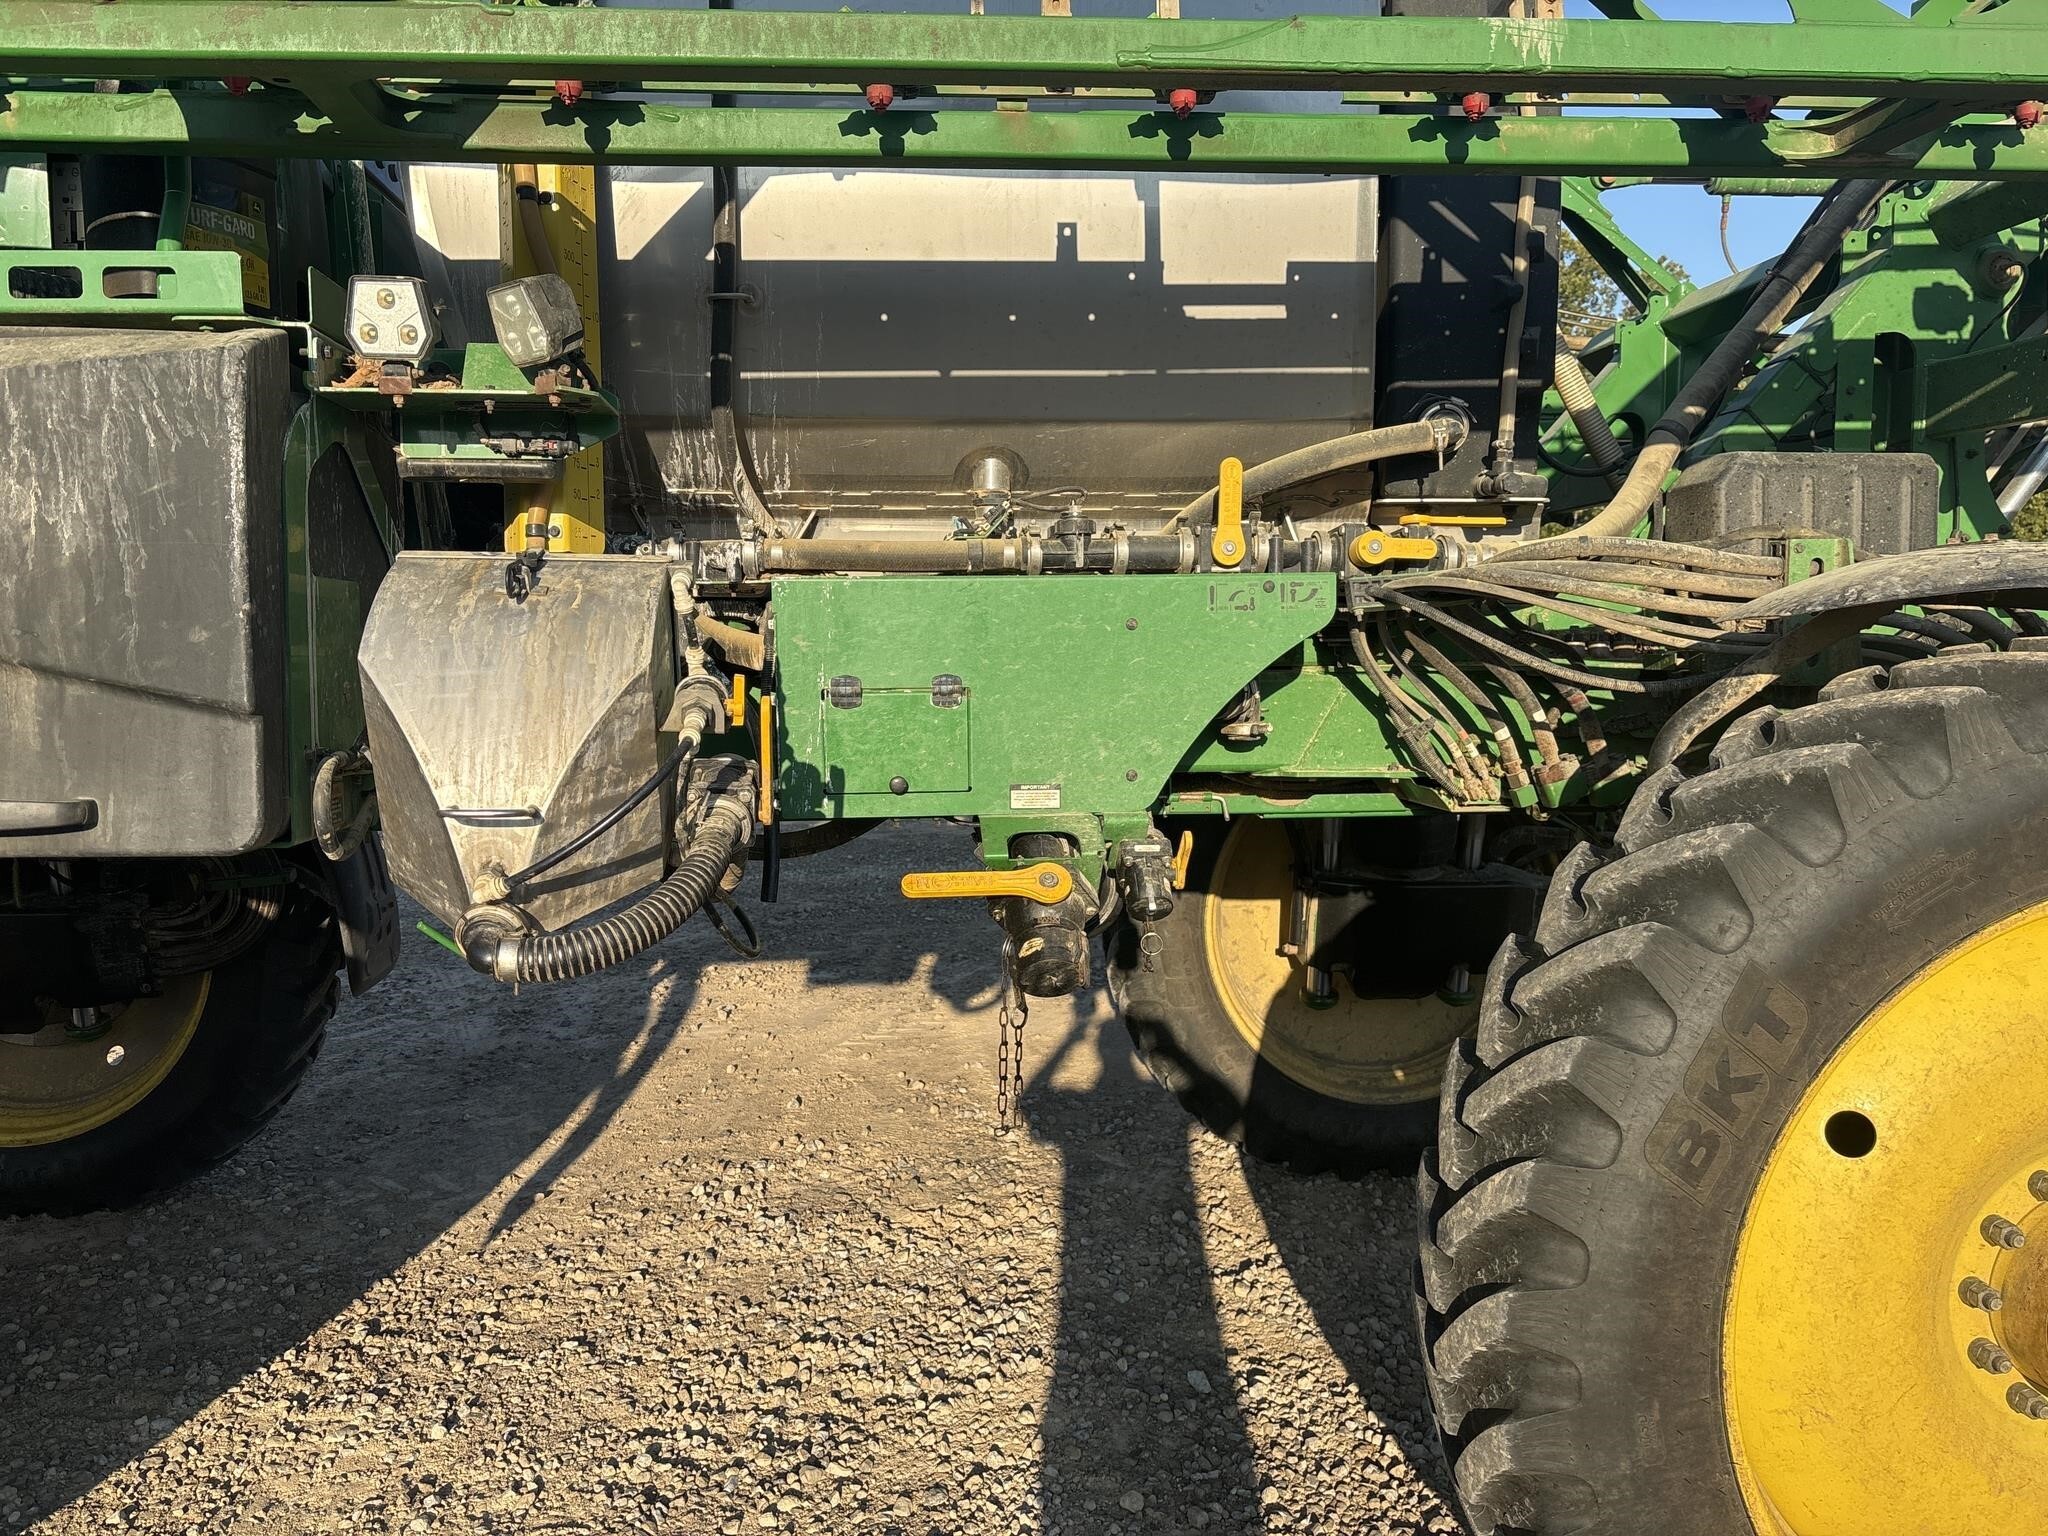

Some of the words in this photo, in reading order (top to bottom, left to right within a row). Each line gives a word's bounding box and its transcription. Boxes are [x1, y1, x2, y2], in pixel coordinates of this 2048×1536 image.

[190, 206, 256, 241] URF-GARD
[563, 248, 575, 263] 300
[573, 456, 581, 469] 75
[573, 488, 582, 500] 50
[1626, 539, 1648, 547] MSHA
[1872, 885, 1919, 921] DIRECTION
[1659, 978, 1791, 1191] BKT
